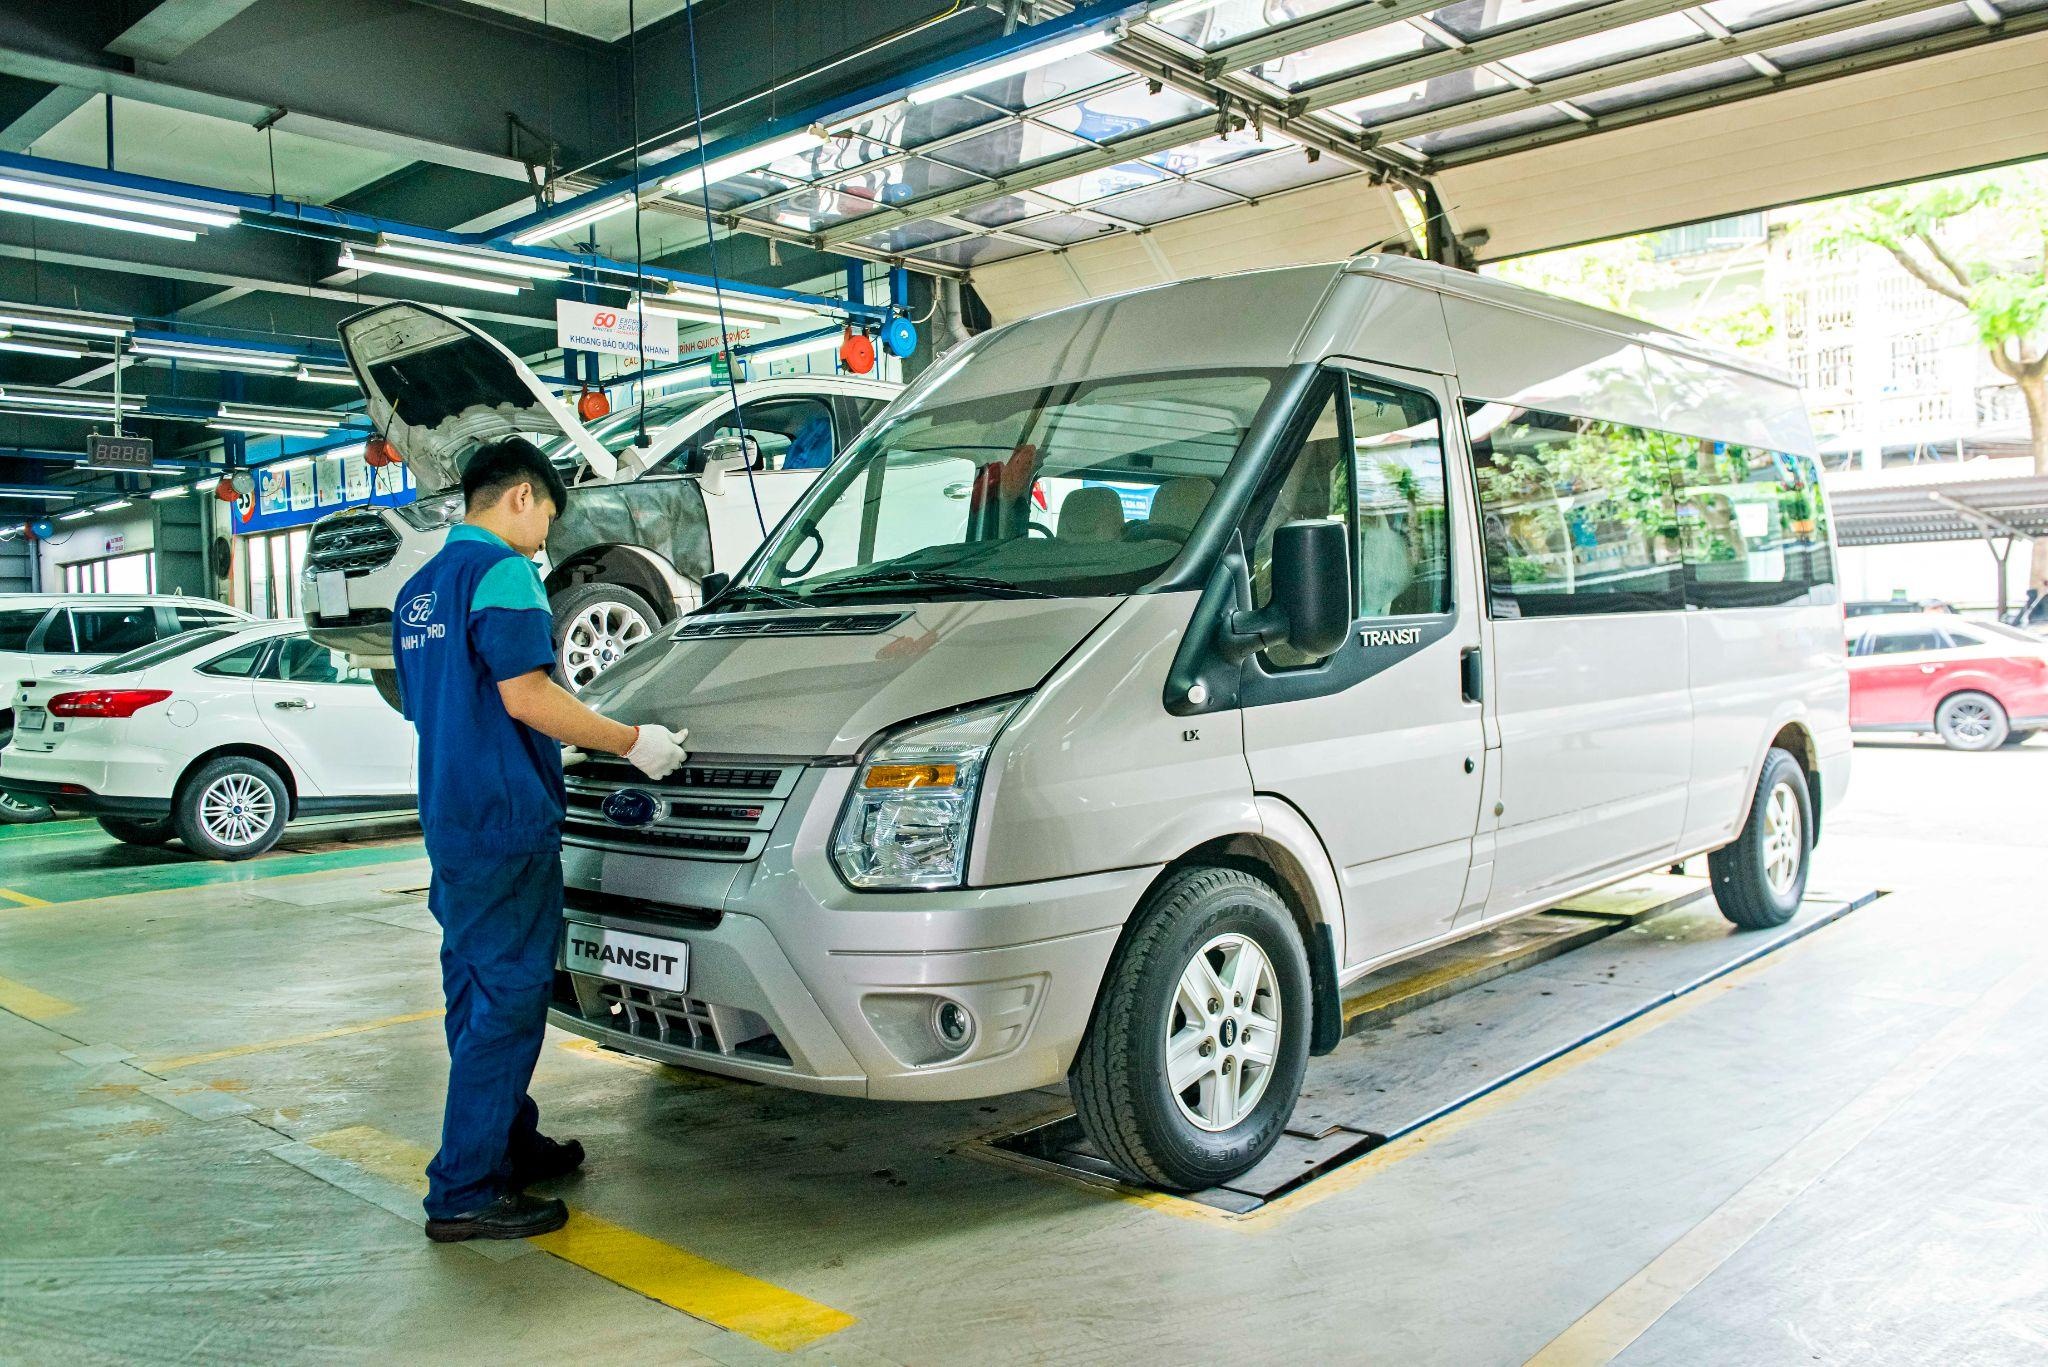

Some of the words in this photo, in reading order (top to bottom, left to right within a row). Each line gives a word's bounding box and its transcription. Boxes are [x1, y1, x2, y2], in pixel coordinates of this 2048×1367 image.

[593, 312, 617, 328] 60
[617, 323, 648, 332] SERVIE
[619, 317, 649, 327] EXPRES
[569, 335, 601, 347] KHOANG
[644, 345, 670, 356] NHANH
[697, 336, 720, 350] QUICK
[1360, 627, 1421, 647] TRANSIT
[1183, 729, 1200, 741] LX
[571, 938, 679, 975] TRANSIT
